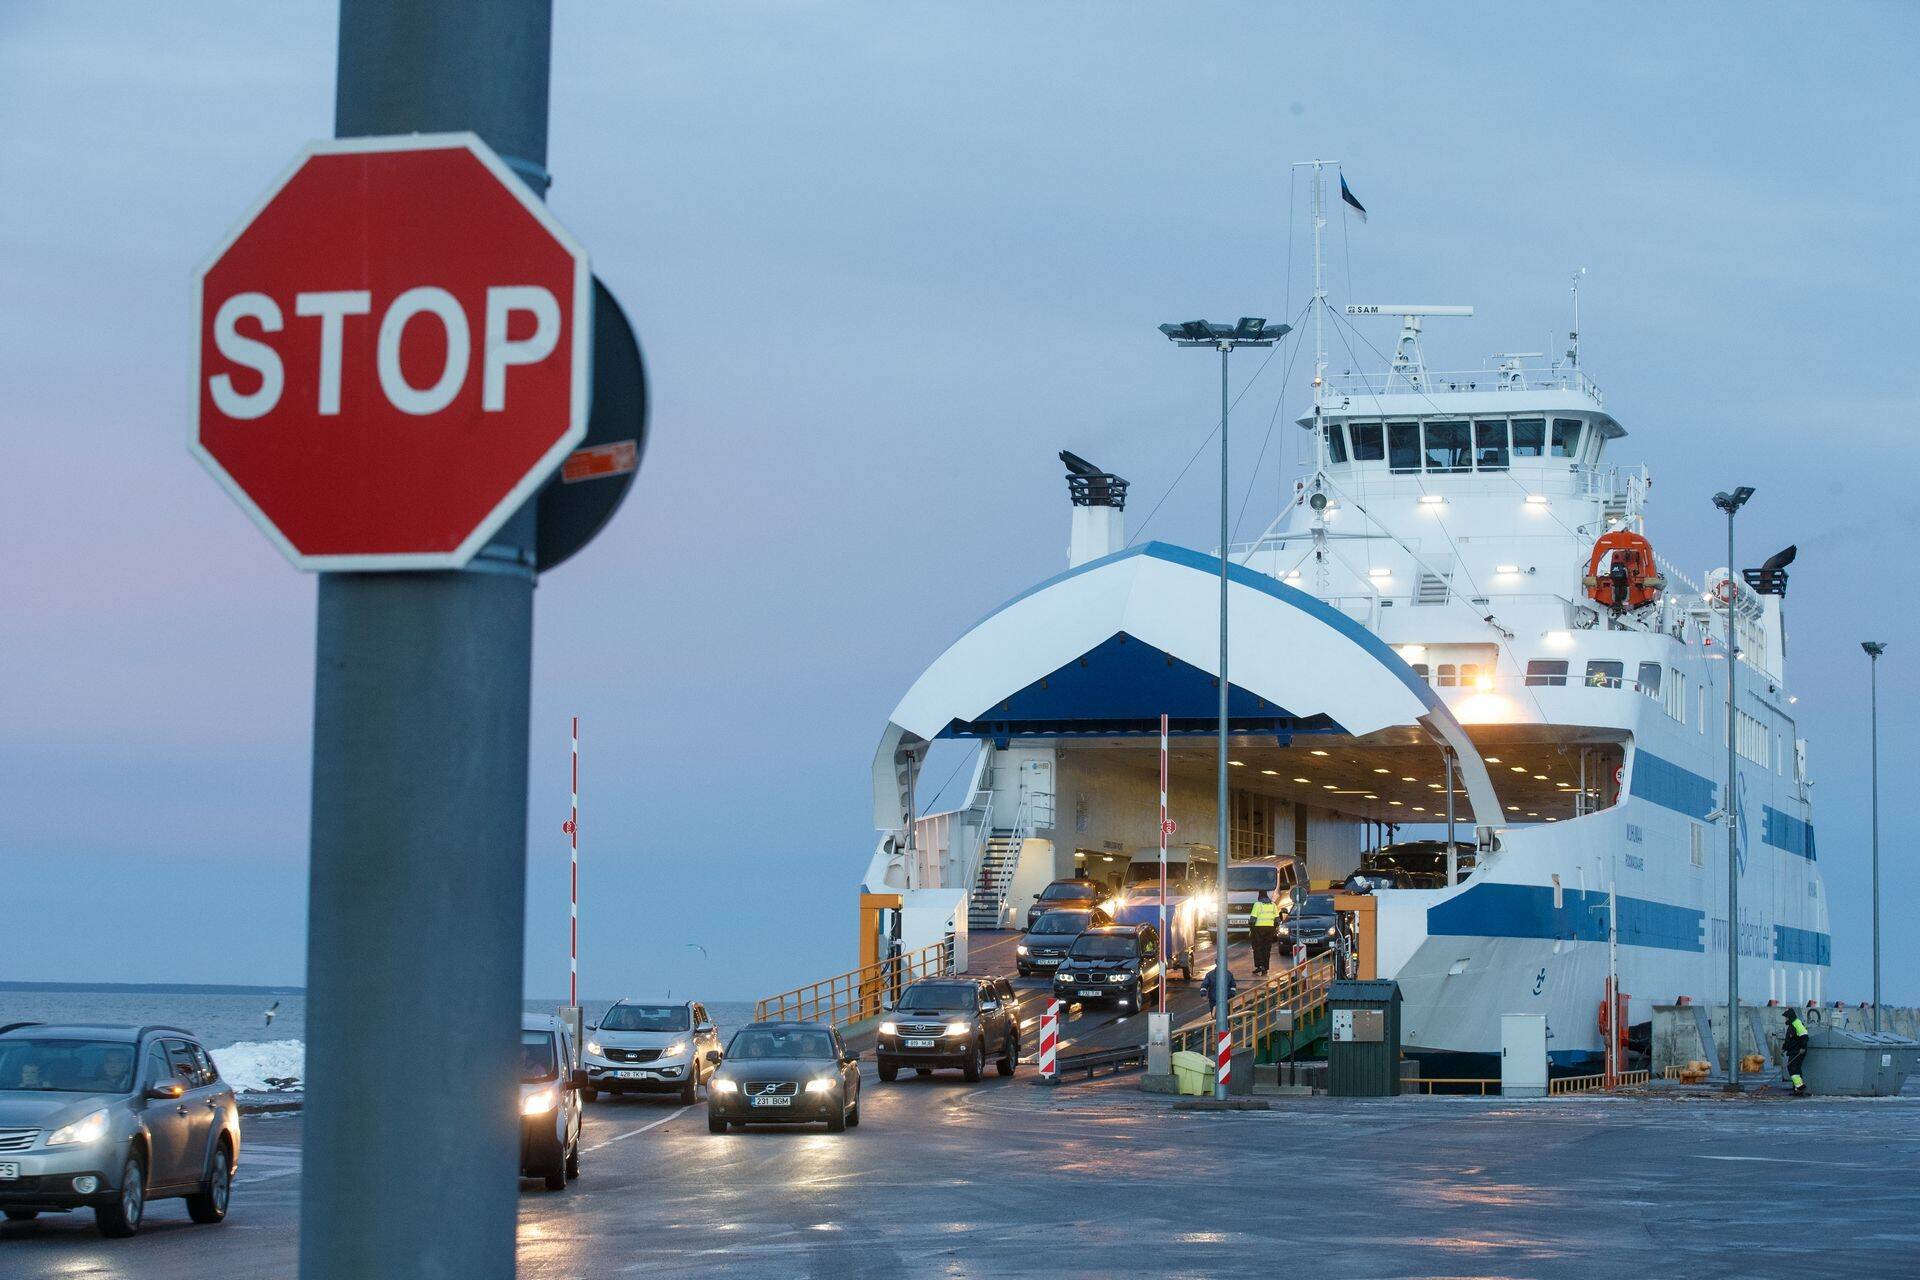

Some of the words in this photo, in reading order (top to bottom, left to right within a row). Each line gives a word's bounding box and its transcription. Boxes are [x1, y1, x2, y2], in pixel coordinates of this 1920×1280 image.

[1357, 306, 1378, 314] SAM
[208, 285, 562, 420] STOP
[757, 1097, 769, 1105] 231
[772, 1097, 789, 1105] BGM
